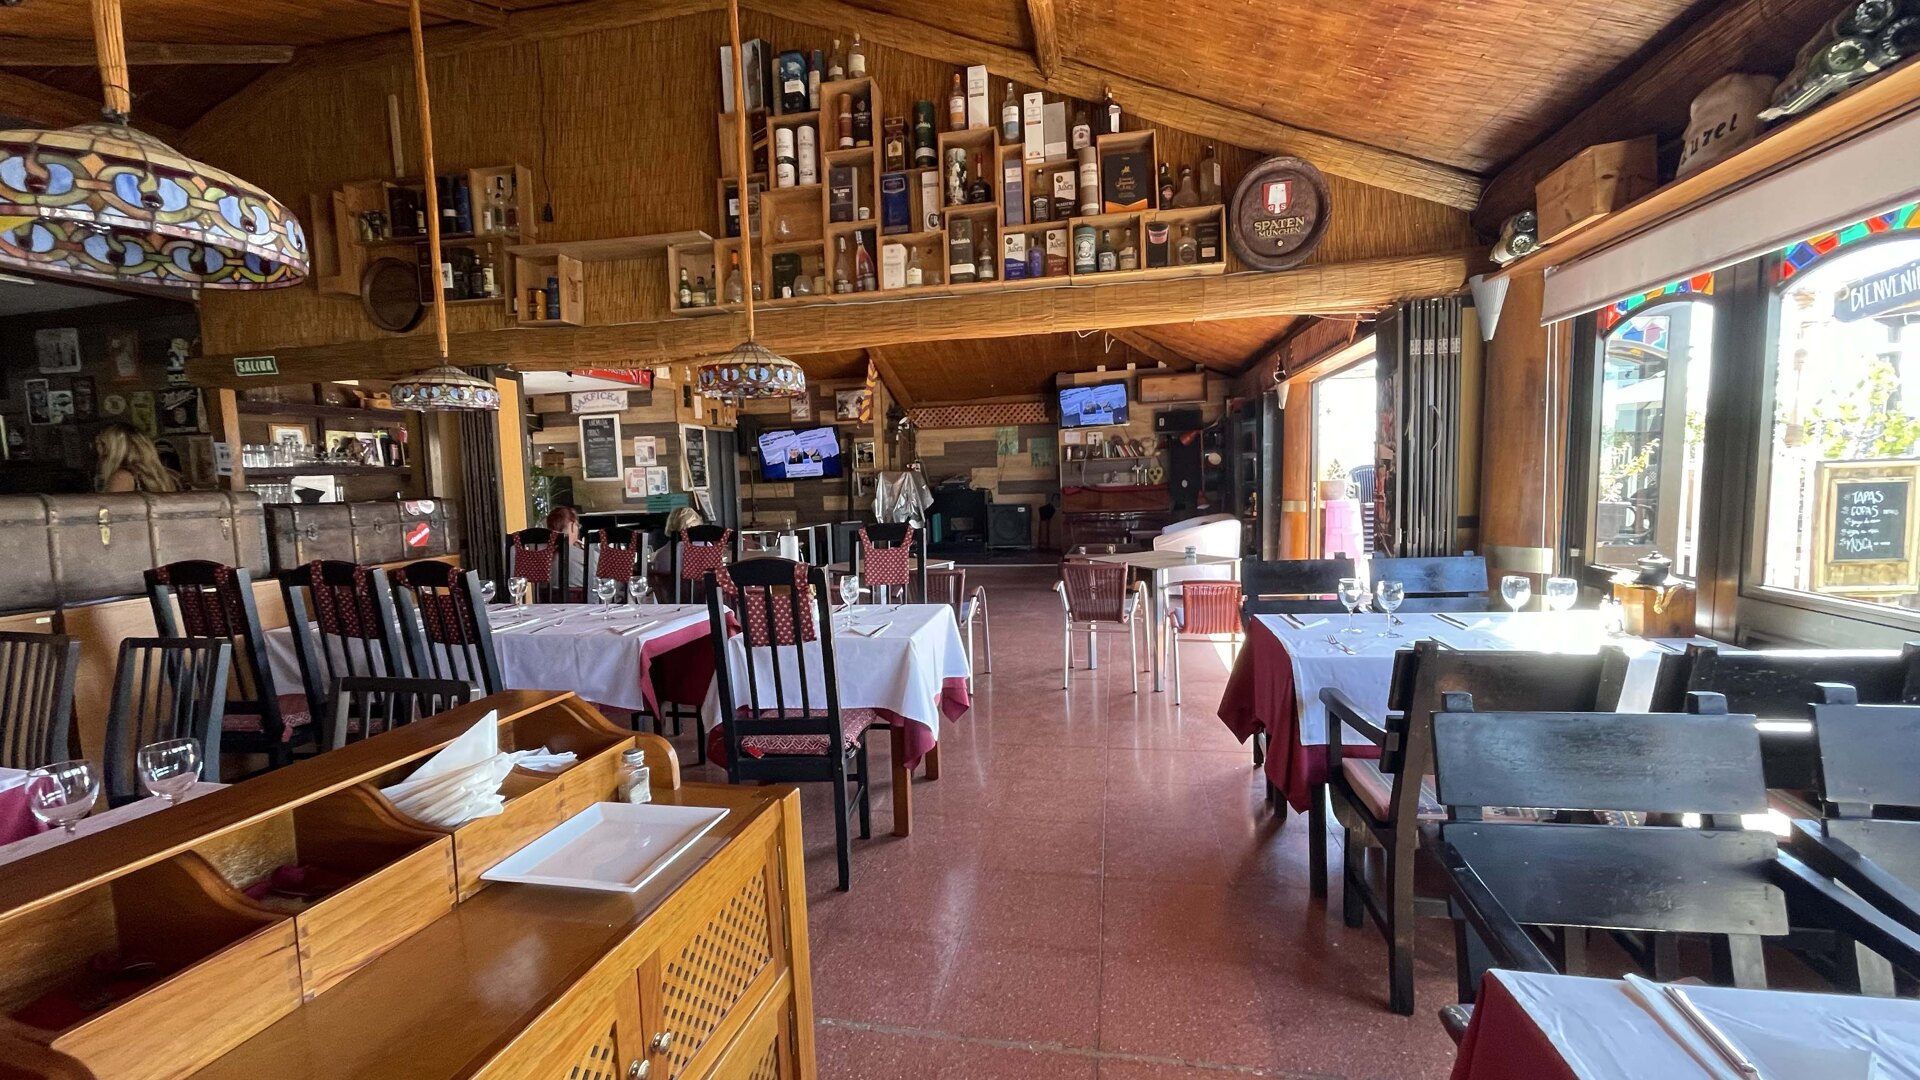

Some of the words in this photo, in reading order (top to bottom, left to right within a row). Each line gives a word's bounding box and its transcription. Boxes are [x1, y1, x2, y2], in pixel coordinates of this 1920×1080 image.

[1254, 216, 1305, 230] SPATEN
[1850, 262, 1920, 312] BIENVENI
[238, 360, 273, 372] SALIDA
[1852, 490, 1884, 504] TAPAS
[1851, 505, 1879, 517] COPAS
